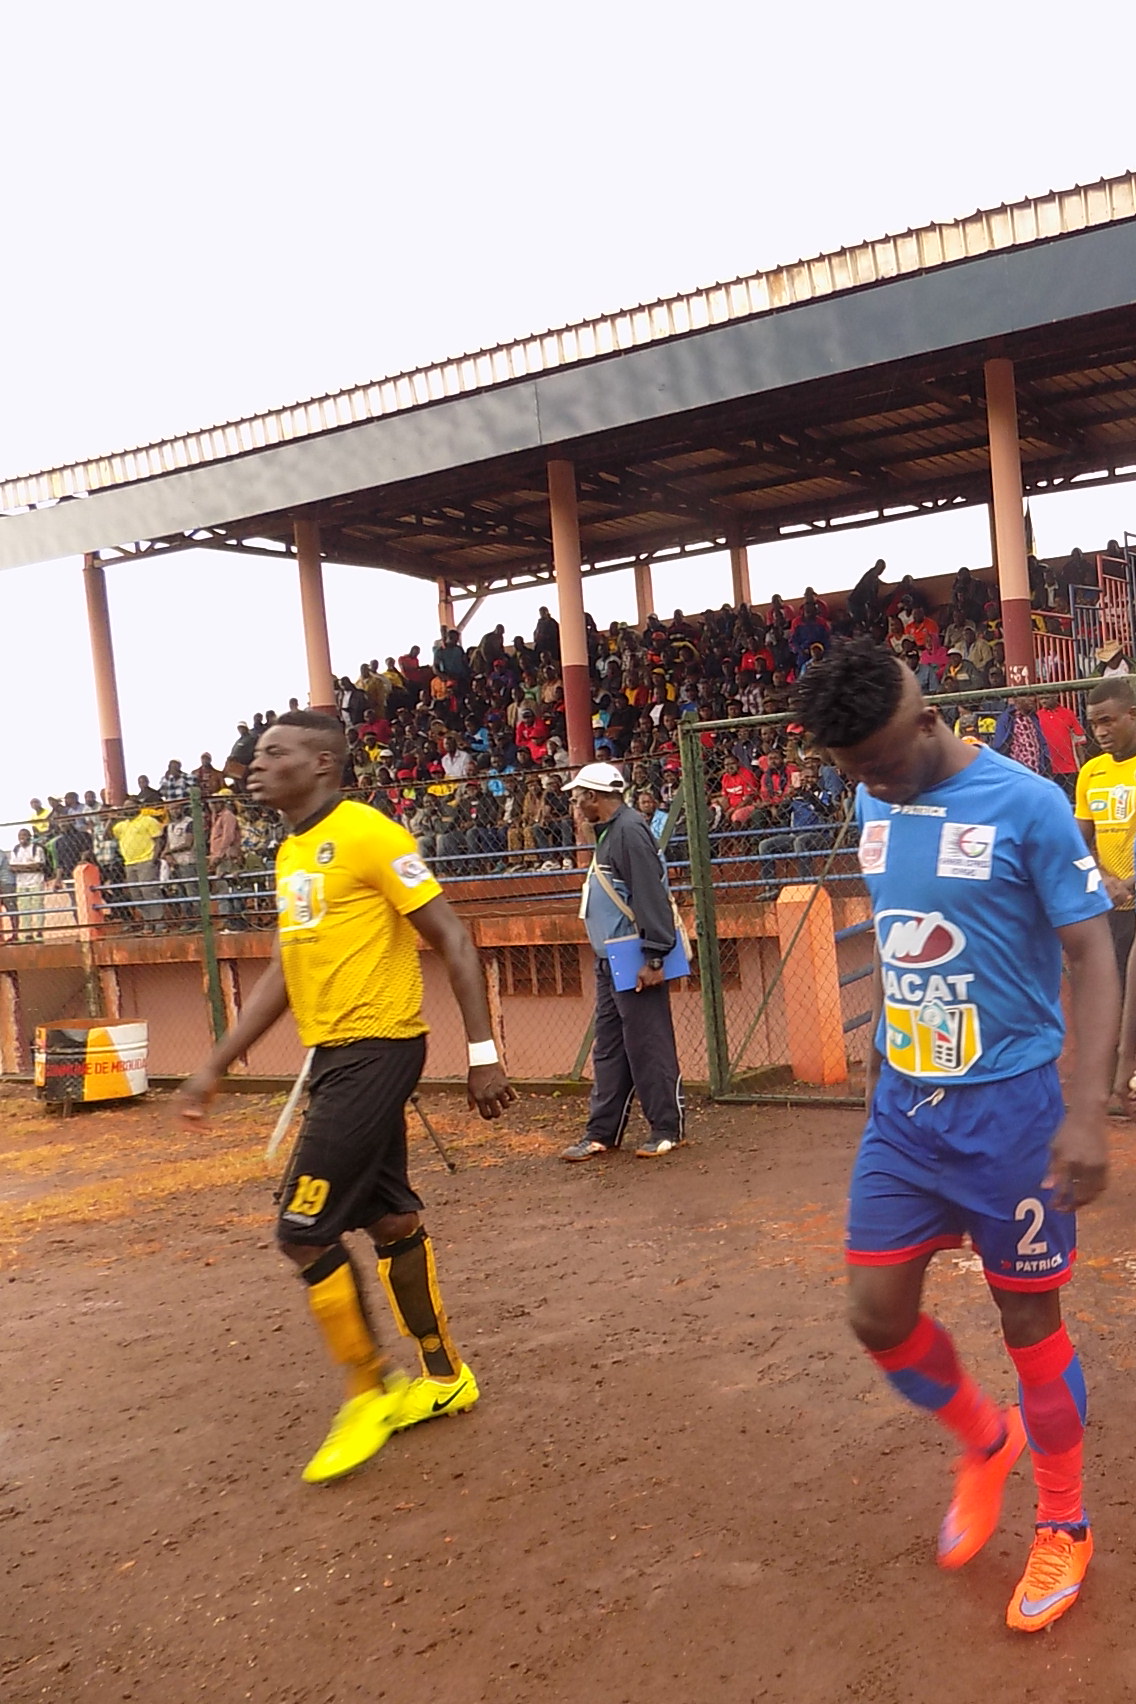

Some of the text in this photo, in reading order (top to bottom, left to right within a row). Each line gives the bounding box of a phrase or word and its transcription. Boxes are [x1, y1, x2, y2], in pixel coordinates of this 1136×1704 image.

[94, 1062, 109, 1075] DE
[288, 1174, 331, 1216] 19
[1015, 1197, 1048, 1256] 2
[1015, 1252, 1063, 1272] PATRICK
